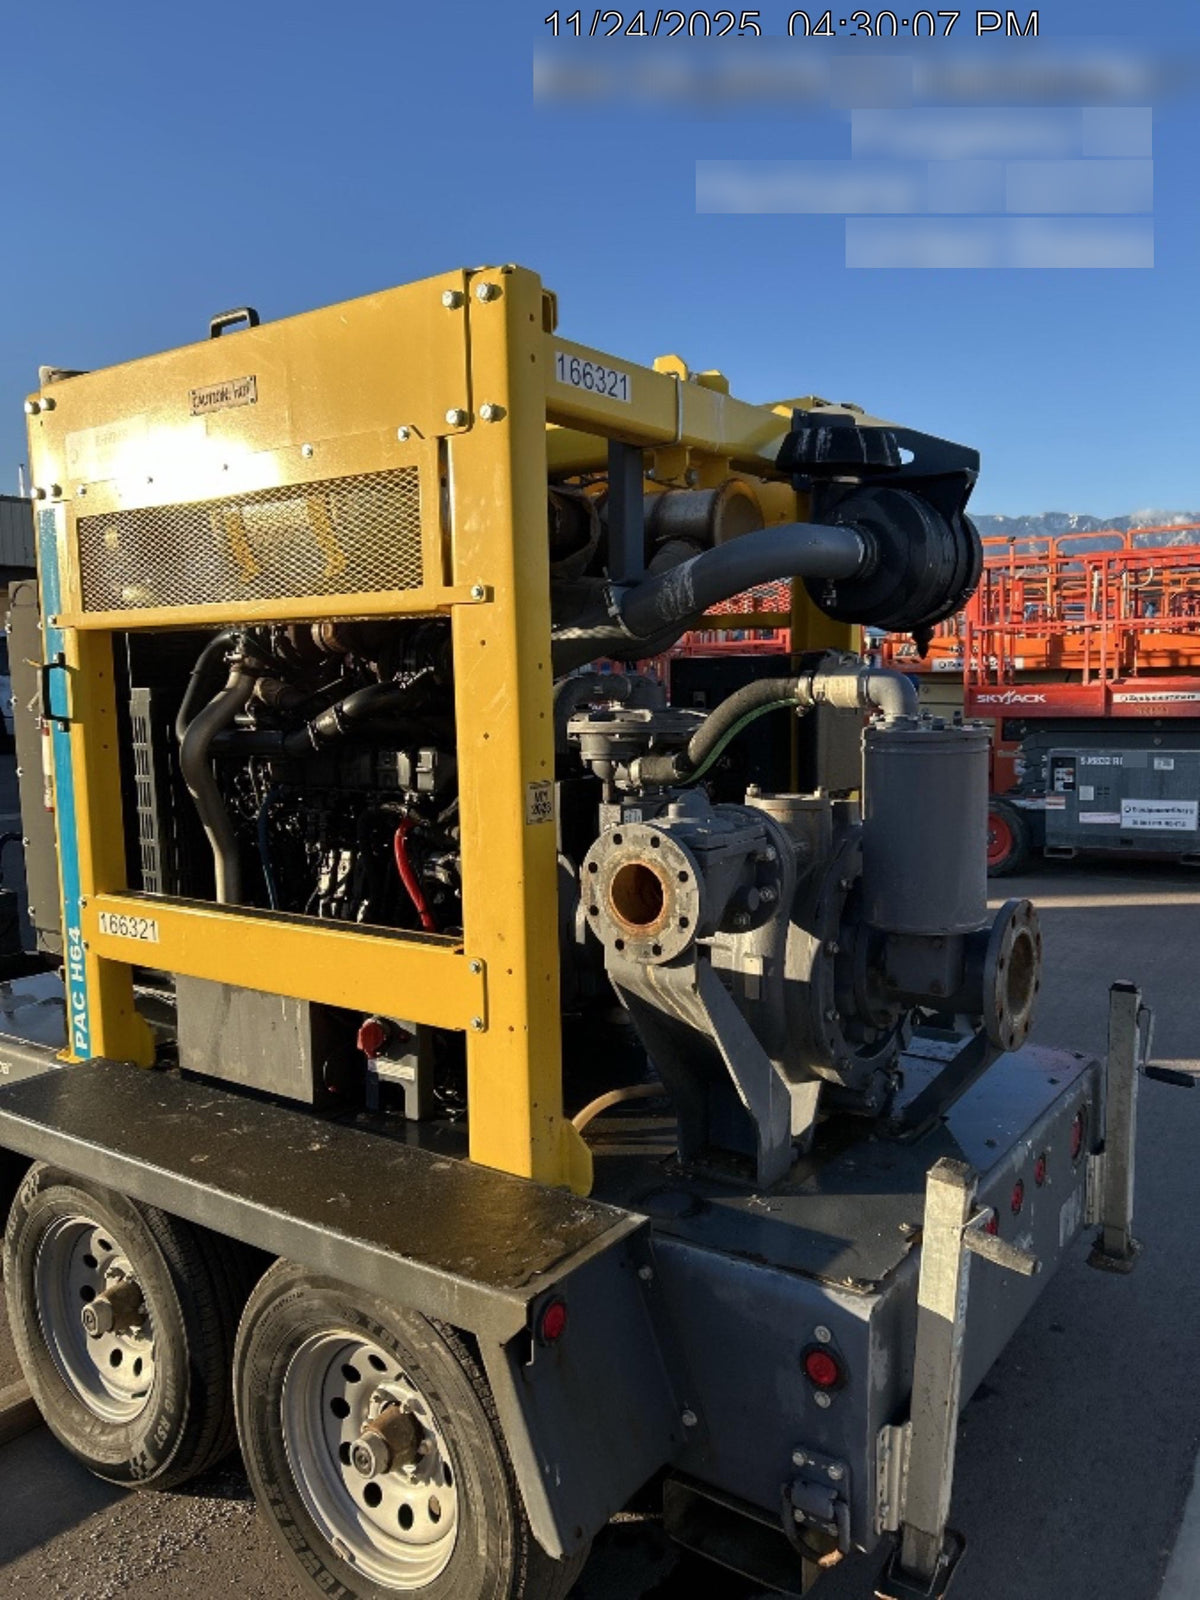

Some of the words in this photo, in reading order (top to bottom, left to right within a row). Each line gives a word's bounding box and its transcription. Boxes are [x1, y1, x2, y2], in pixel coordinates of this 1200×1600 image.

[557, 353, 628, 401] 166321
[976, 690, 1047, 705] SKYJACK
[100, 913, 157, 941] 166321
[68, 926, 85, 982] H64
[72, 991, 89, 1050] PAC
